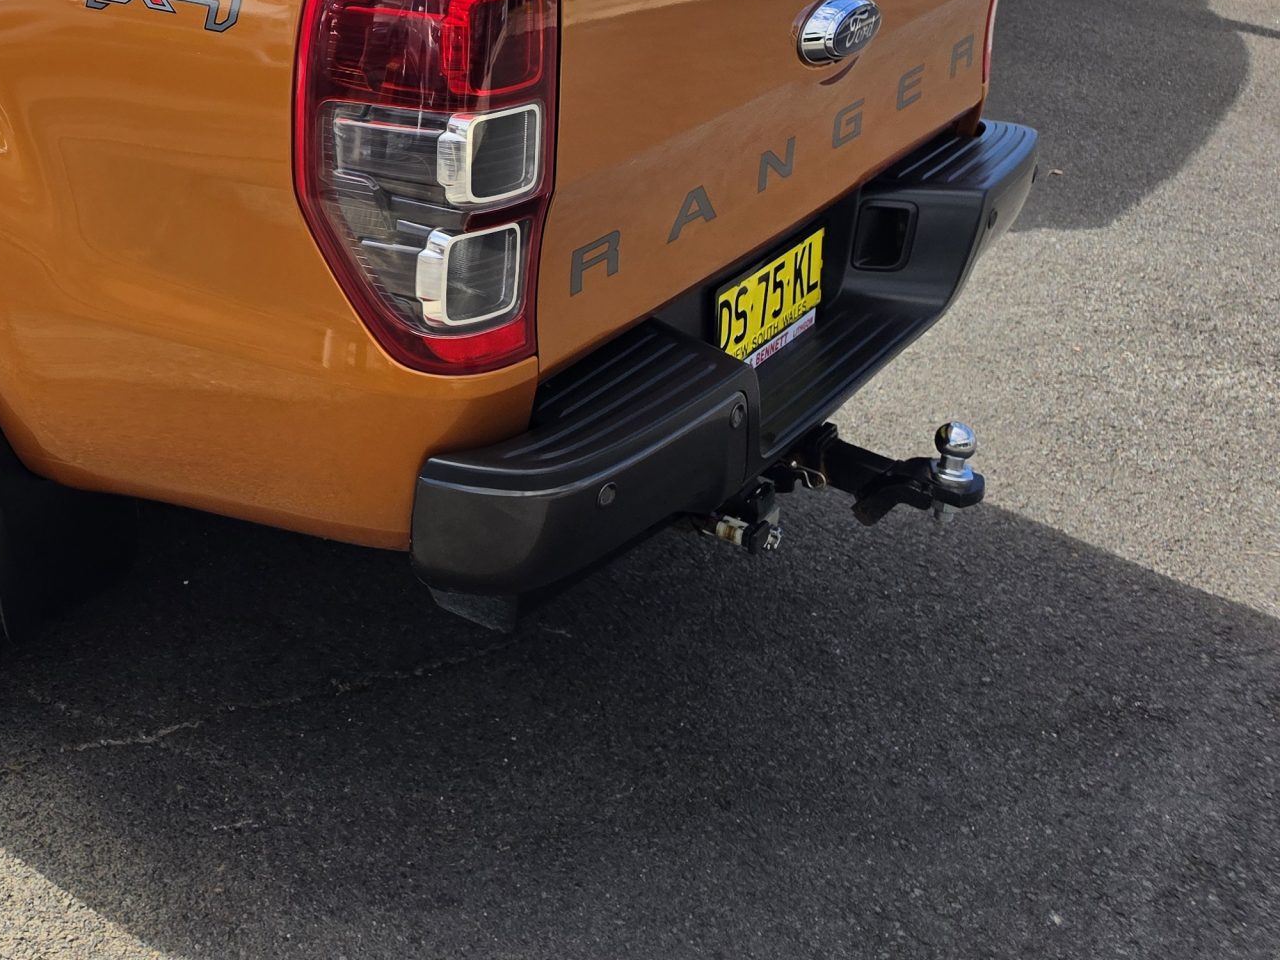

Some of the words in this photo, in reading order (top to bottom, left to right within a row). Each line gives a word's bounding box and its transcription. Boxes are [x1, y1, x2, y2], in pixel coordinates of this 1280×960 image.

[845, 7, 877, 49] Ford
[569, 33, 975, 298] RANGER
[752, 323, 779, 350] SOUTH
[783, 300, 807, 326] WALES
[755, 332, 789, 365] BENNETT
